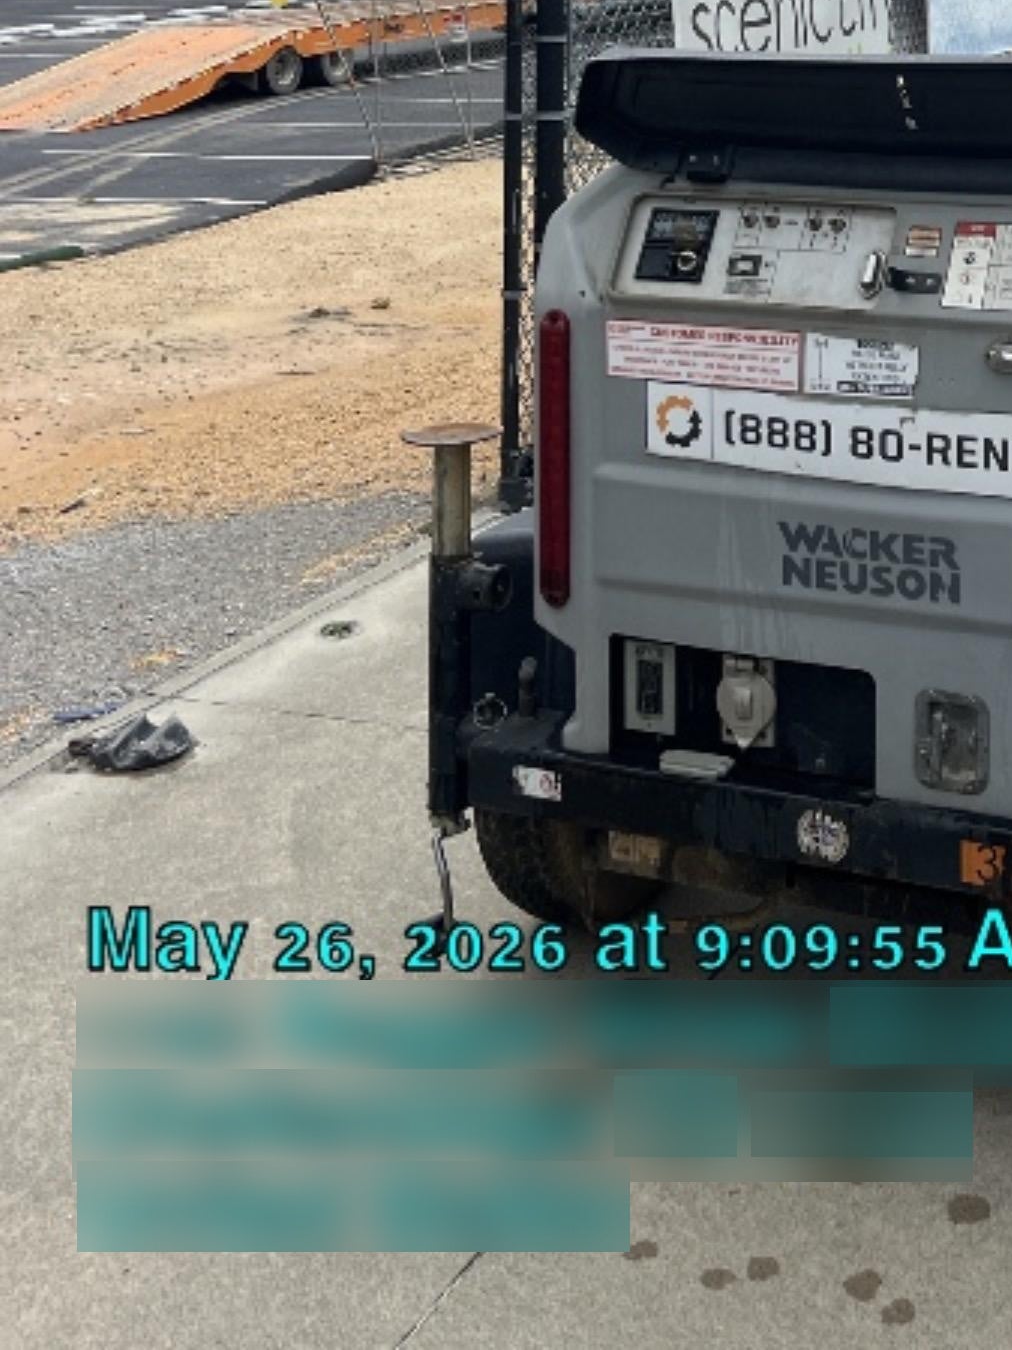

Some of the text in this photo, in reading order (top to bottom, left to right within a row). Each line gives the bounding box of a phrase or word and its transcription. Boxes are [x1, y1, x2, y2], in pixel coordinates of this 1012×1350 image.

[723, 409, 833, 458] (888)
[777, 520, 961, 571] WACKER
[781, 554, 961, 605] NEUSON
